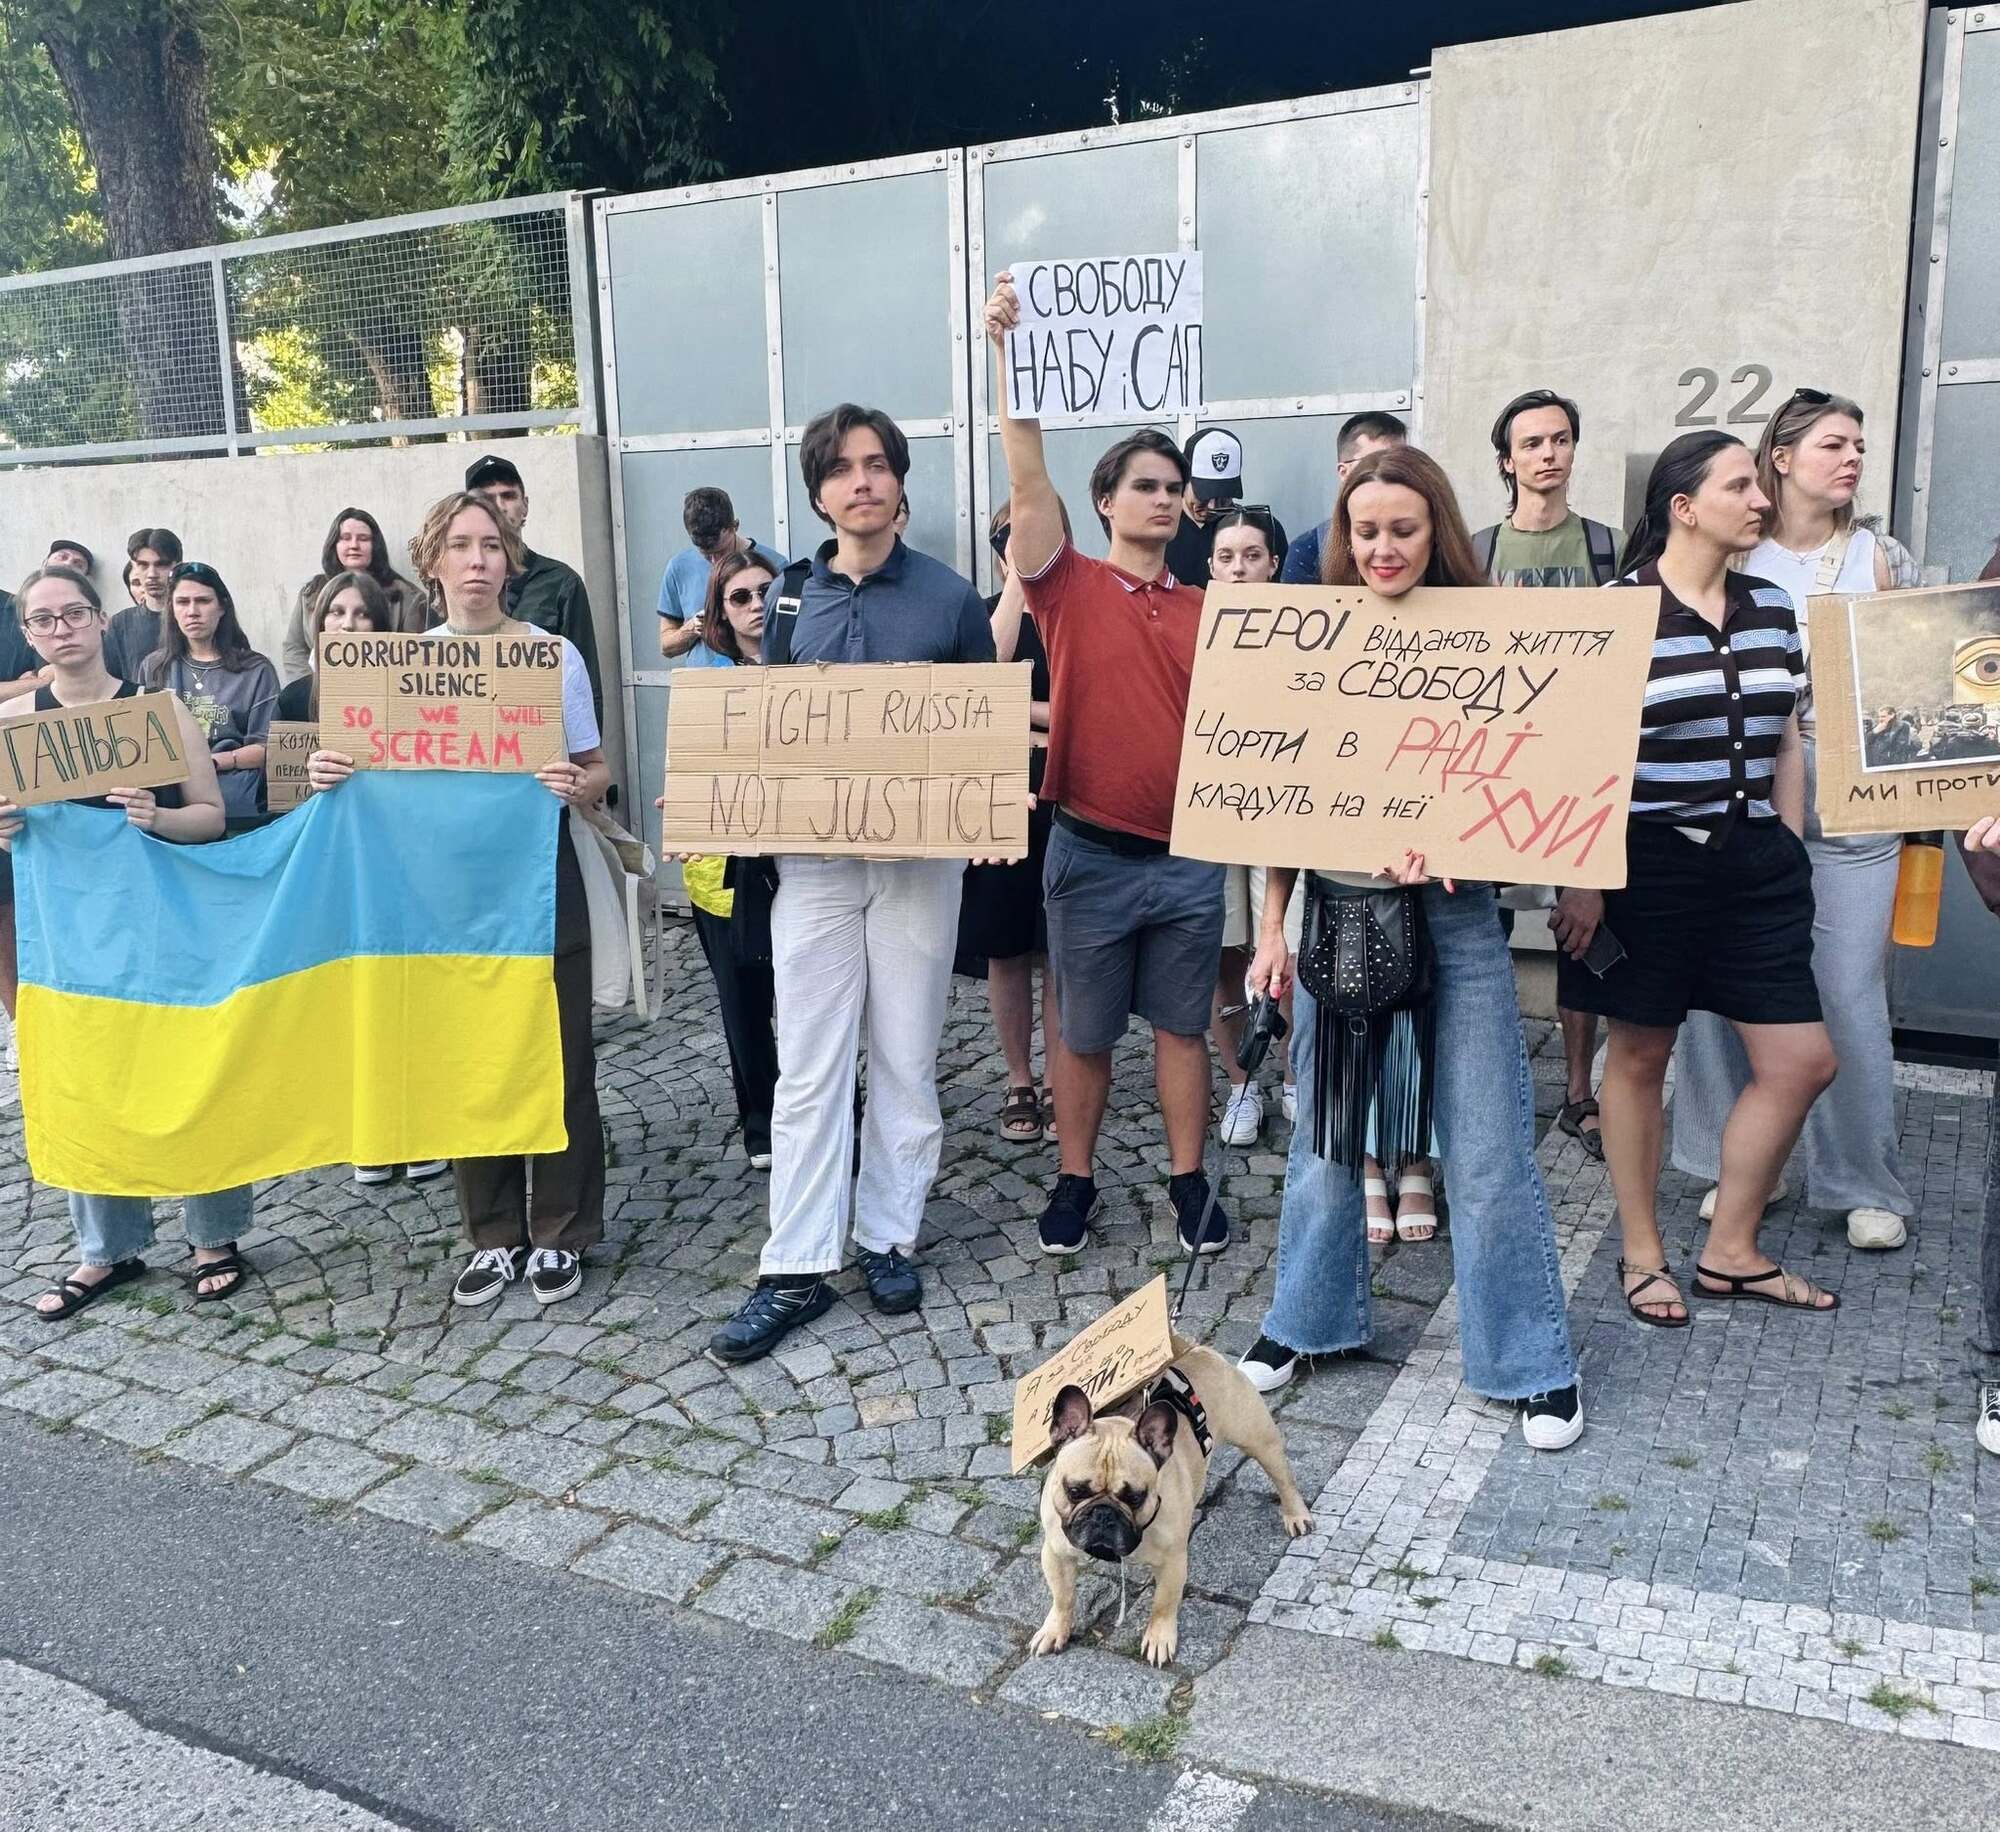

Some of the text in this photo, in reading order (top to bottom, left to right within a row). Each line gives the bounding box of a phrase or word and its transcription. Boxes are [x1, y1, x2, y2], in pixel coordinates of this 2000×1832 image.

[1028, 257, 1186, 319] СВОБОДУ
[1011, 327, 1115, 413] НАБУ
[1131, 323, 1203, 411] САП
[1675, 364, 1773, 427] 22
[323, 639, 561, 670] CORRUPTION LOVES
[1205, 597, 1364, 652] ГЕРОЇ
[342, 704, 546, 729] SO WE WILL
[1286, 660, 1559, 724] за СВОБОДУ
[2, 710, 180, 793] ГАНЬБА
[275, 762, 309, 777] ПЕРЕМ
[368, 729, 525, 767] SCREAM
[1384, 716, 1544, 794] РАДІ
[710, 772, 1017, 843] NOT JUSTICE
[1328, 791, 1365, 817] на
[1382, 794, 1434, 820] неї
[1457, 774, 1620, 868] ХУЙ
[1848, 783, 1898, 803] ми
